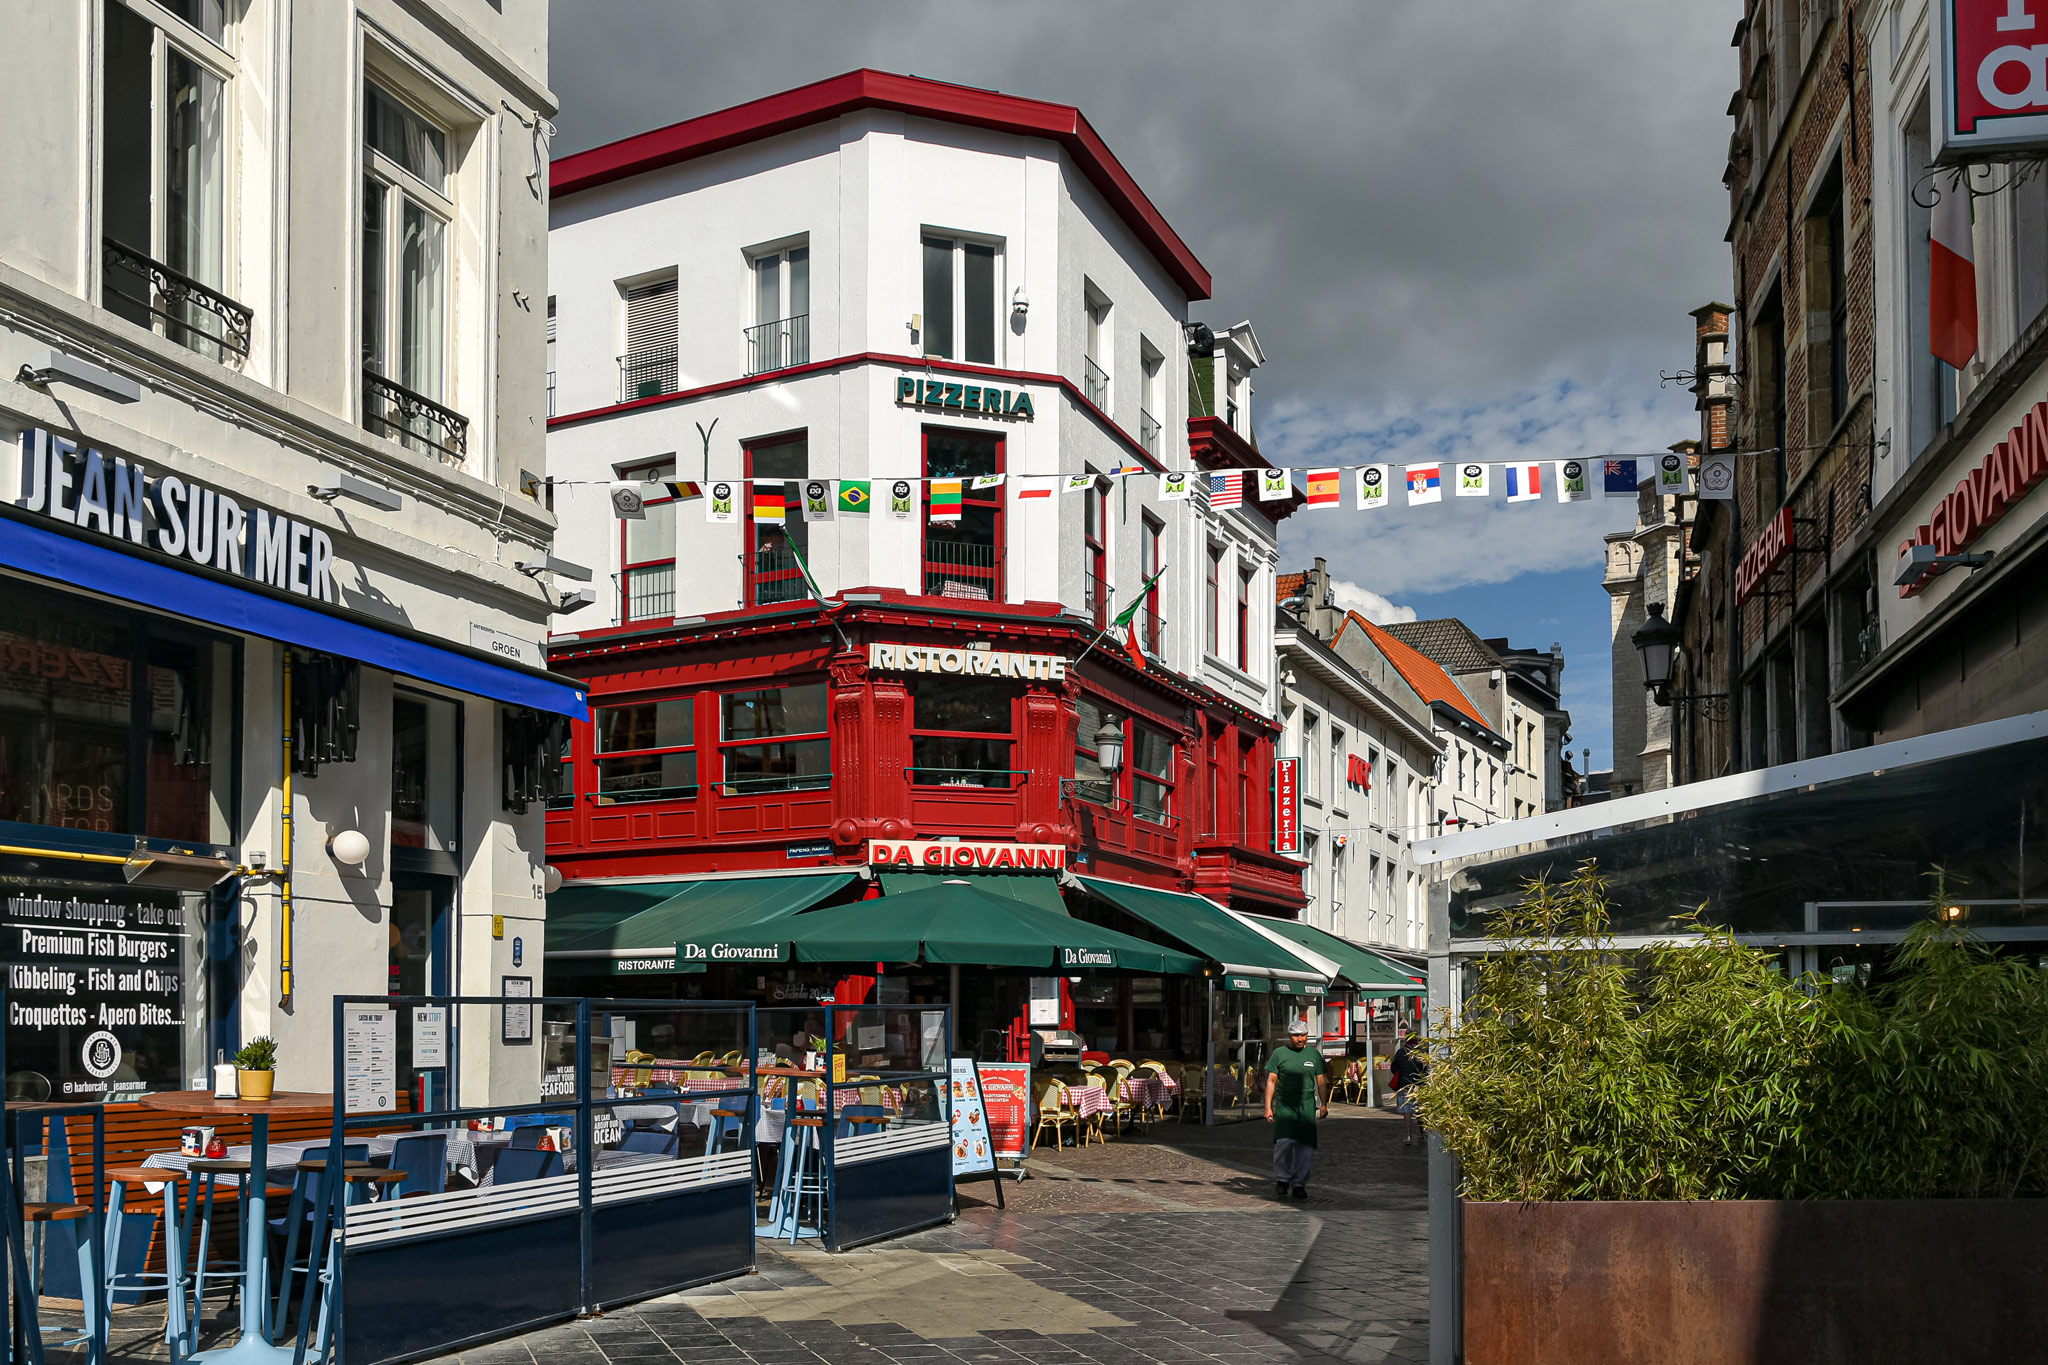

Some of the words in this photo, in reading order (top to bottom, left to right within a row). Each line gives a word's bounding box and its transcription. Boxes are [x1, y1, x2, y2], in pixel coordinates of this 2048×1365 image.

[897, 377, 1035, 416] PIZZERIA
[20, 428, 145, 545] JEAN
[158, 476, 243, 576] SUR
[255, 508, 334, 605] MER
[1735, 508, 1786, 607] PIZZERIA
[492, 641, 521, 658] GROEN
[873, 644, 1067, 681] RISTORANTE
[1347, 754, 1373, 790] KFC
[1281, 760, 1292, 851] Pizzeria
[873, 845, 915, 865] DA
[923, 845, 1065, 868] GIOVANNI
[532, 884, 543, 900] 15
[7, 892, 62, 919] window
[65, 896, 126, 928] shopping
[137, 902, 164, 926] take
[167, 906, 187, 926] out
[22, 929, 84, 955] Premium
[87, 932, 115, 957] Fish
[118, 934, 168, 963] Burgers
[684, 943, 707, 959] Da
[711, 943, 779, 959] Giovanni
[618, 959, 675, 971] RISTORANTE
[1065, 948, 1078, 964] Da
[1078, 948, 1112, 964] Giovanni
[9, 965, 76, 996] Kibbeling
[88, 967, 115, 991] Fish
[118, 969, 142, 991] and
[144, 969, 179, 997] Chips
[9, 1001, 87, 1031] Croquettes
[98, 1002, 137, 1031] Apero
[417, 1013, 428, 1022] NEW
[428, 1012, 442, 1022] STUFF
[545, 1074, 561, 1083] ABOUT
[561, 1073, 574, 1082] YOUR
[556, 1066, 563, 1074] WE
[564, 1065, 574, 1073] CARE
[540, 1081, 574, 1096] SEAFOOD
[594, 1114, 601, 1122] WE
[601, 1113, 610, 1121] CARE
[594, 1121, 609, 1129] ABOUT
[609, 1119, 618, 1128] OUR
[593, 1127, 621, 1145] OCEAN
